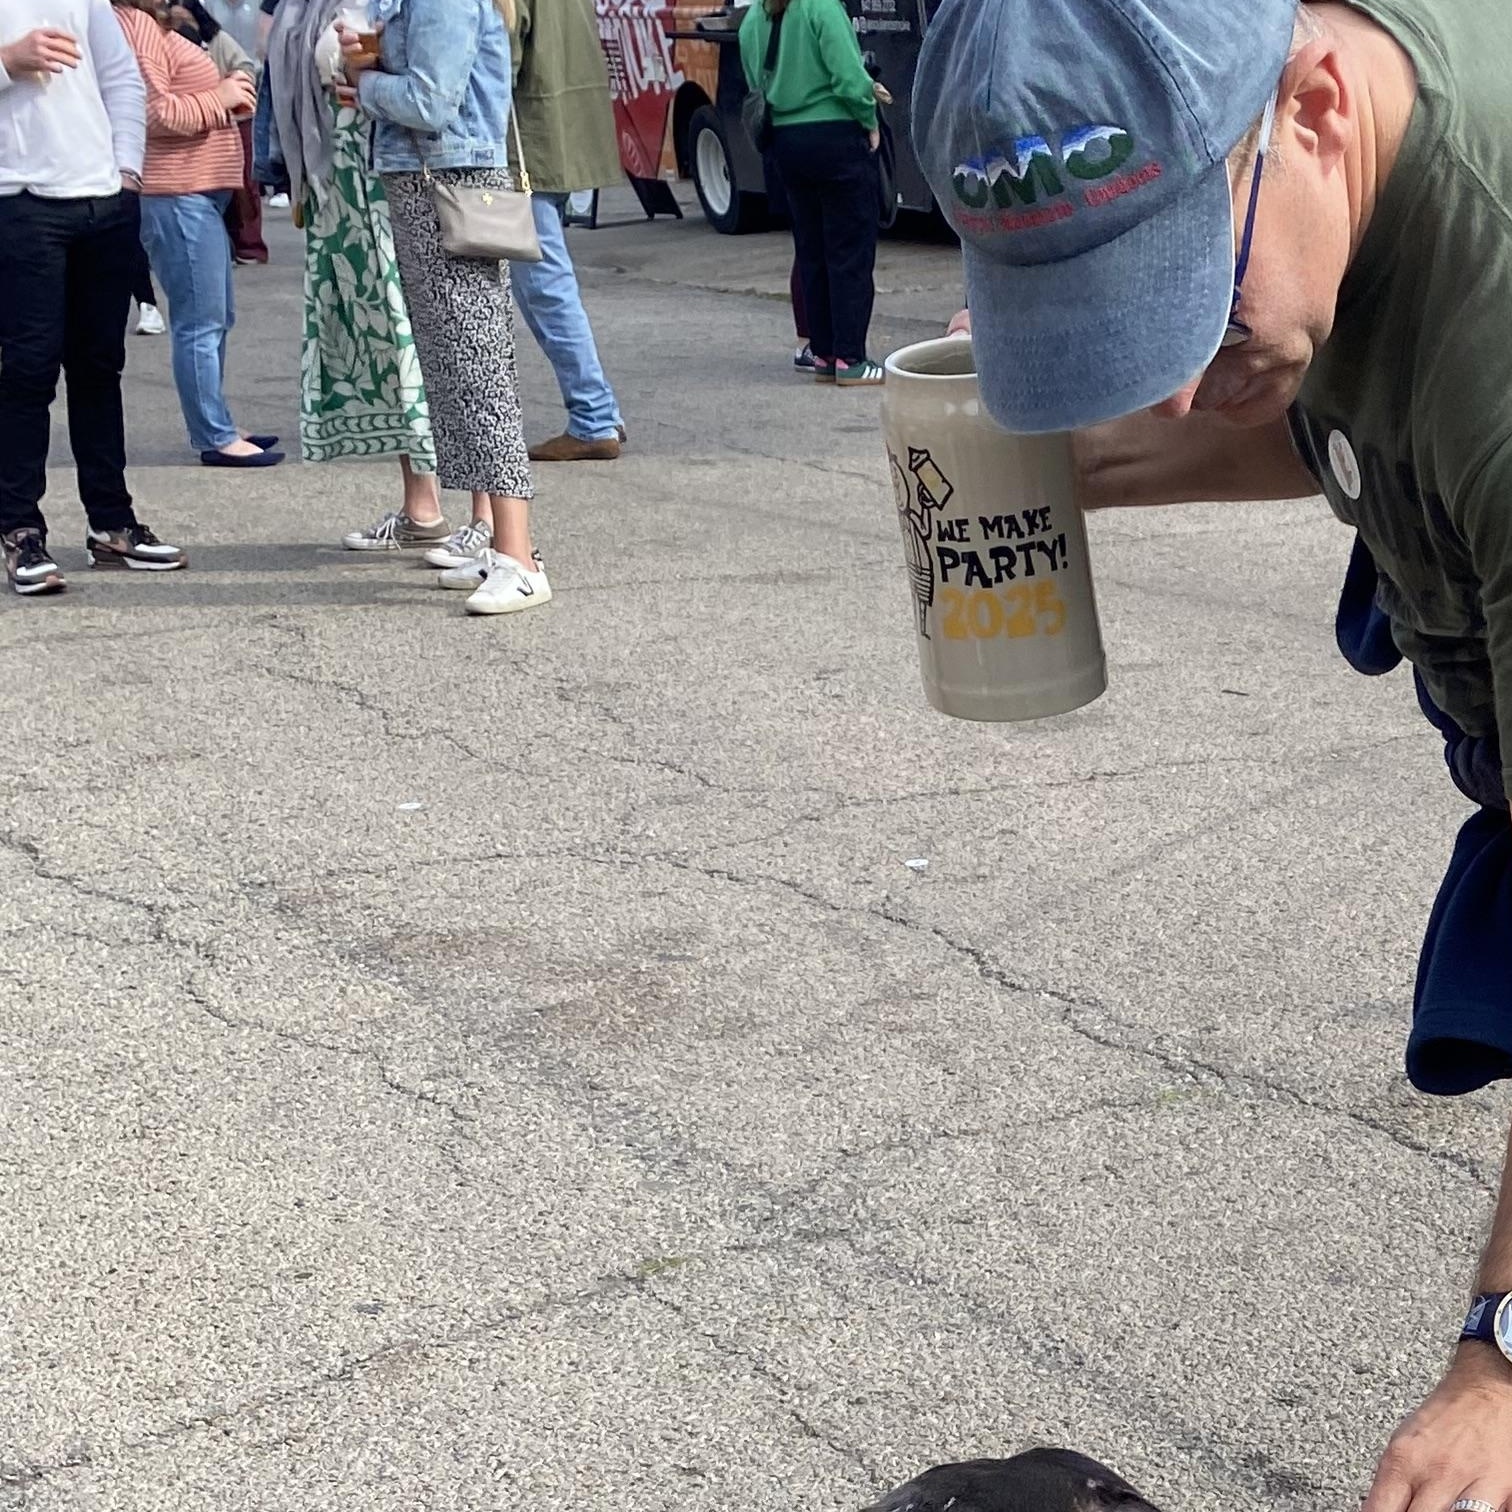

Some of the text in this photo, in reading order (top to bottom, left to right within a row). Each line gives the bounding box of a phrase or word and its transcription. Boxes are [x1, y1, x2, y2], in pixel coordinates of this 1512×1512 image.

[936, 505, 1052, 543] WE MAKE
[936, 533, 1068, 588] PARTY!
[939, 579, 1067, 640] 2025
